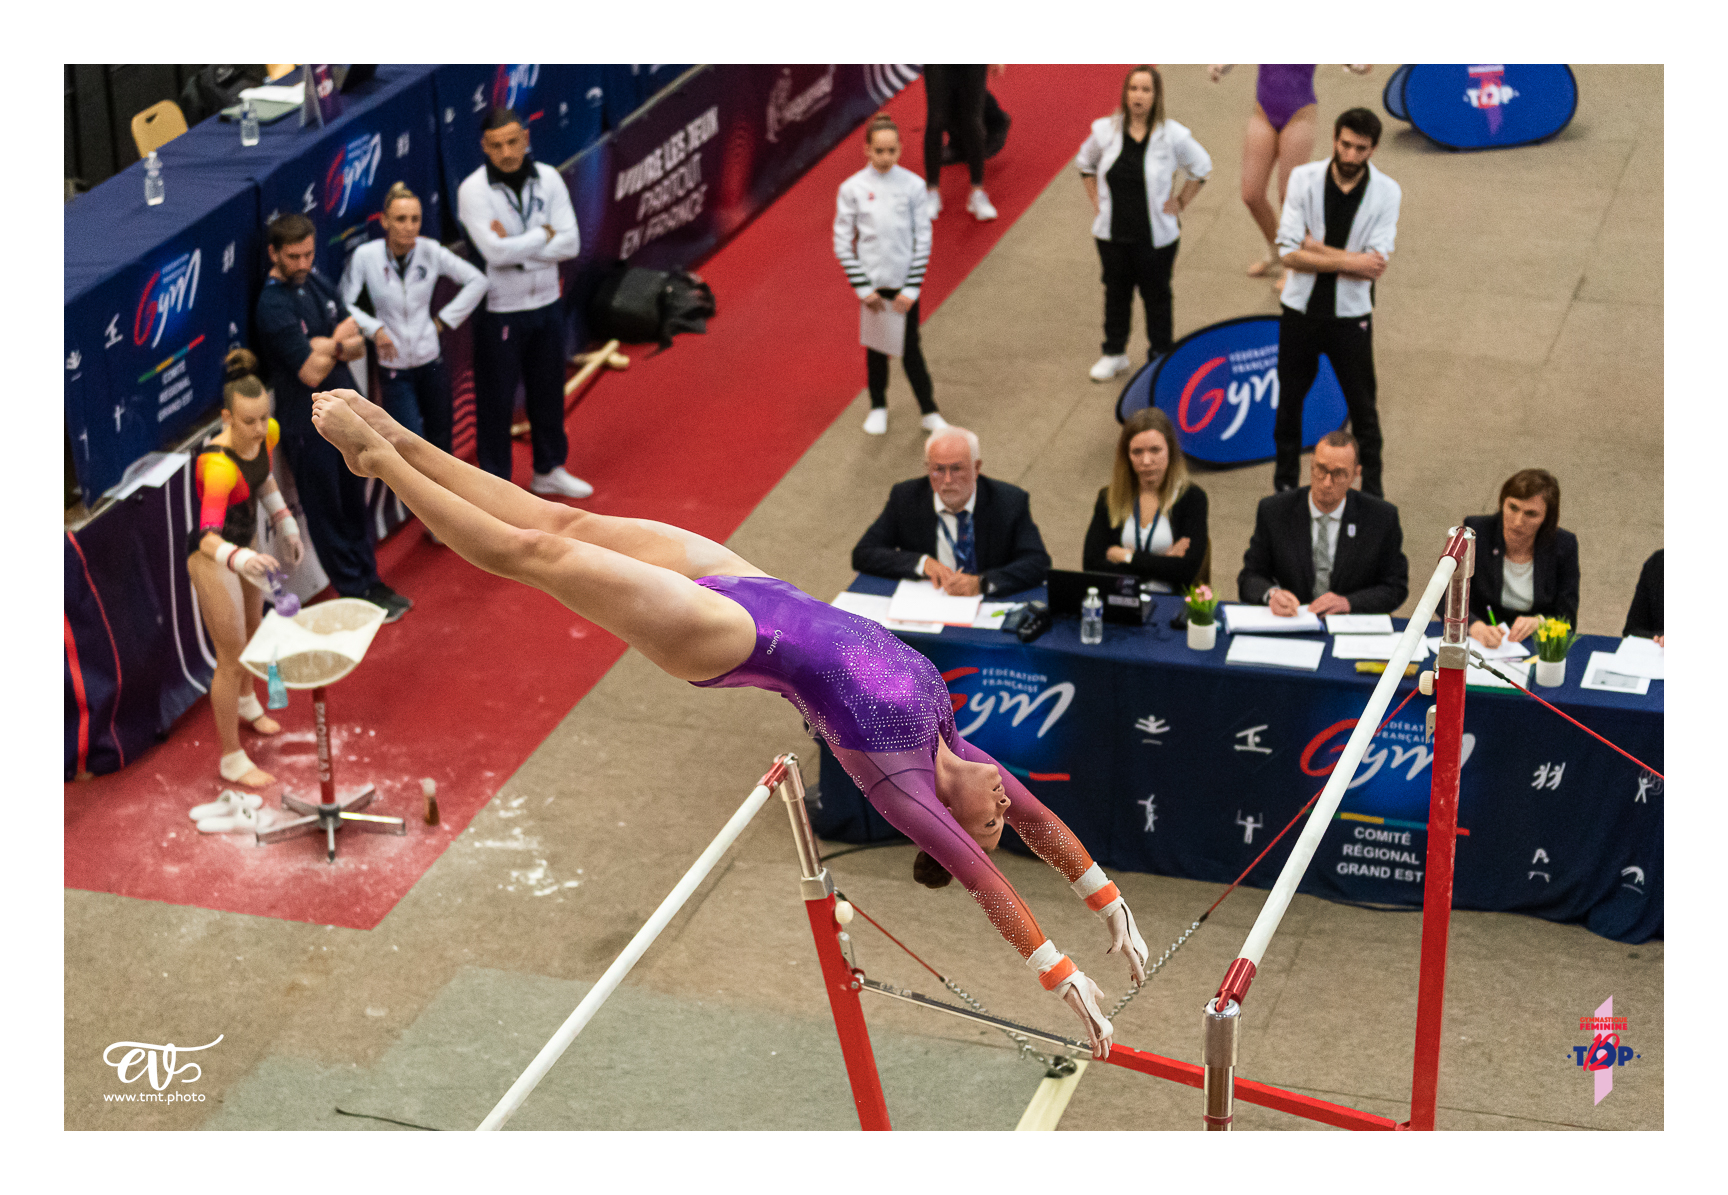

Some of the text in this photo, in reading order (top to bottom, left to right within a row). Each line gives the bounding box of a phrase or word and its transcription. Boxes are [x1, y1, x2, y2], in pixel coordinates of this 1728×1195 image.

[133, 248, 201, 349] Gym
[1353, 826, 1411, 846] COMITÉ
[1342, 843, 1420, 865] RÉGIONAL
[1336, 862, 1424, 883] GRAND EST
